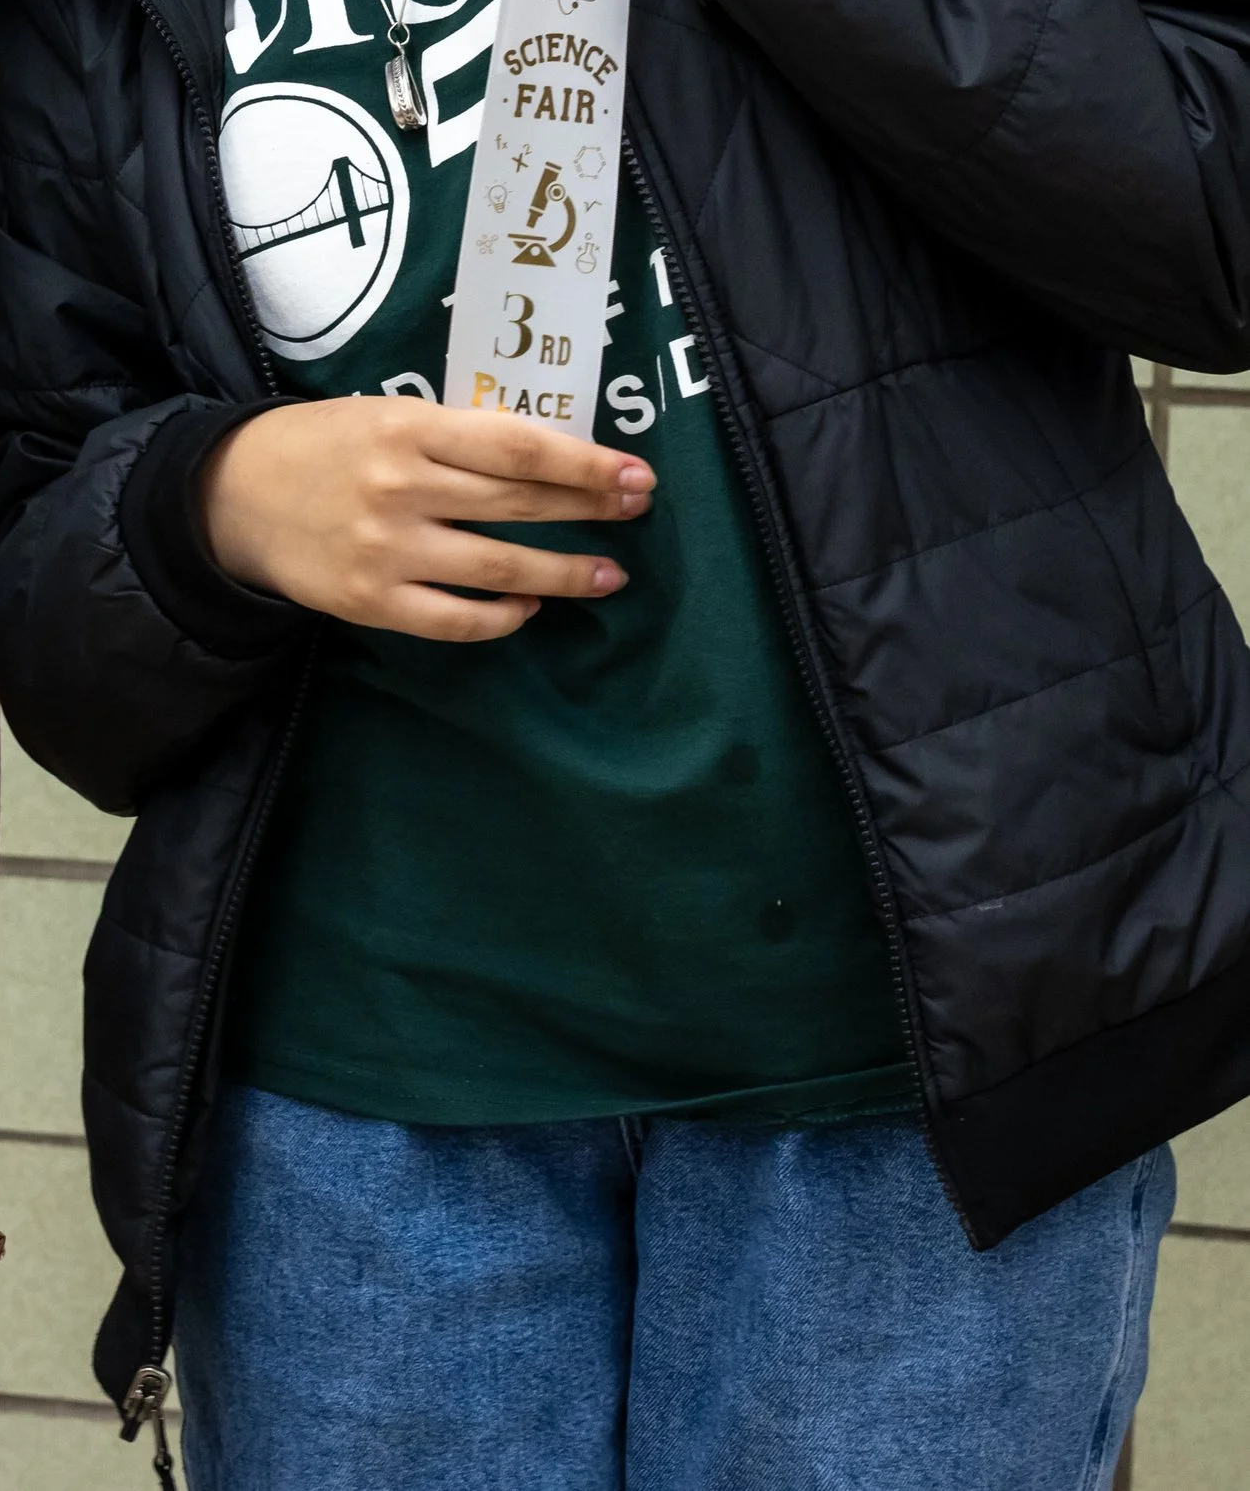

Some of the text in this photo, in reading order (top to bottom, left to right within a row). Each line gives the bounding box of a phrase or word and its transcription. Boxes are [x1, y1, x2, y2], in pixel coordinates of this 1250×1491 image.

[503, 33, 619, 87] SCIENCE
[513, 83, 596, 125] FAIR
[470, 371, 575, 421] PLACE
